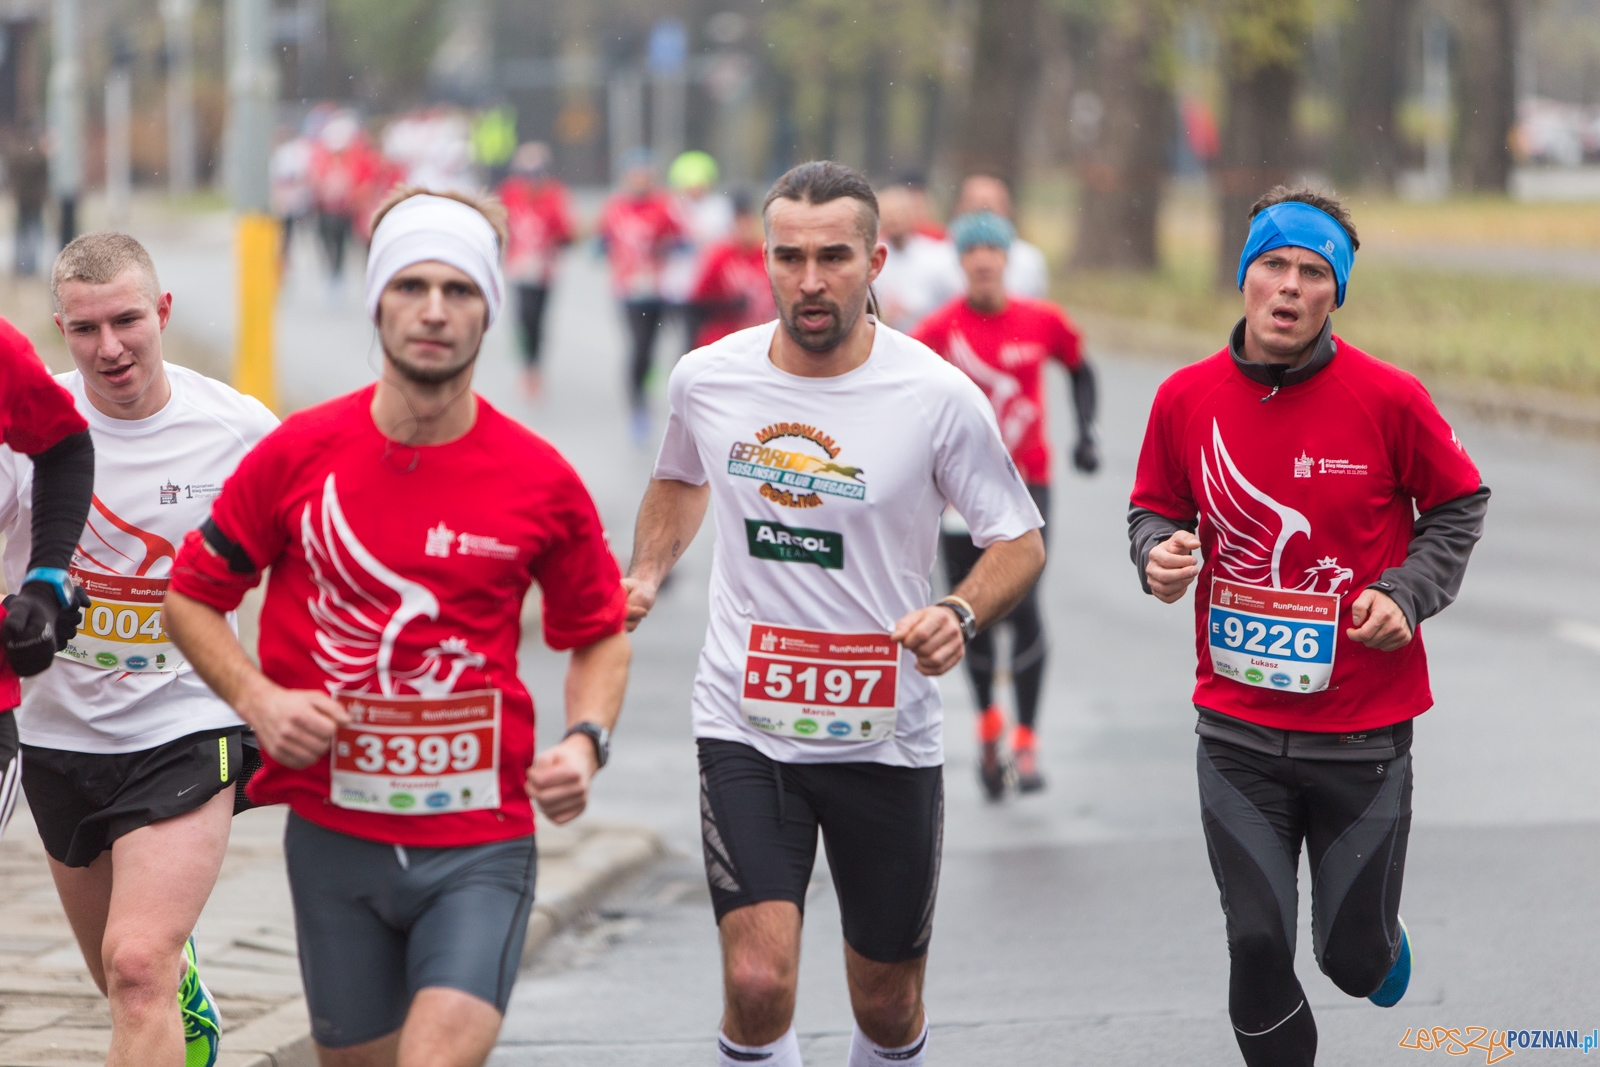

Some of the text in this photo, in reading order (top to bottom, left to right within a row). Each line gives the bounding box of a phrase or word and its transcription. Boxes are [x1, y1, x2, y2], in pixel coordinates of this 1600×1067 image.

[754, 422, 841, 459] MUROWANA
[1318, 458, 1327, 474] 1
[782, 471, 811, 489] KLUB
[811, 478, 864, 498] BIEGACZA
[130, 588, 168, 596] RunPolan
[1272, 602, 1328, 615] RunPoland.org
[77, 605, 170, 641] 1004
[1212, 616, 1320, 659] E 9226
[1250, 658, 1279, 669] Łukasz
[748, 662, 882, 704] B 5197
[802, 708, 836, 717] Marcin
[354, 732, 481, 775] 3399
